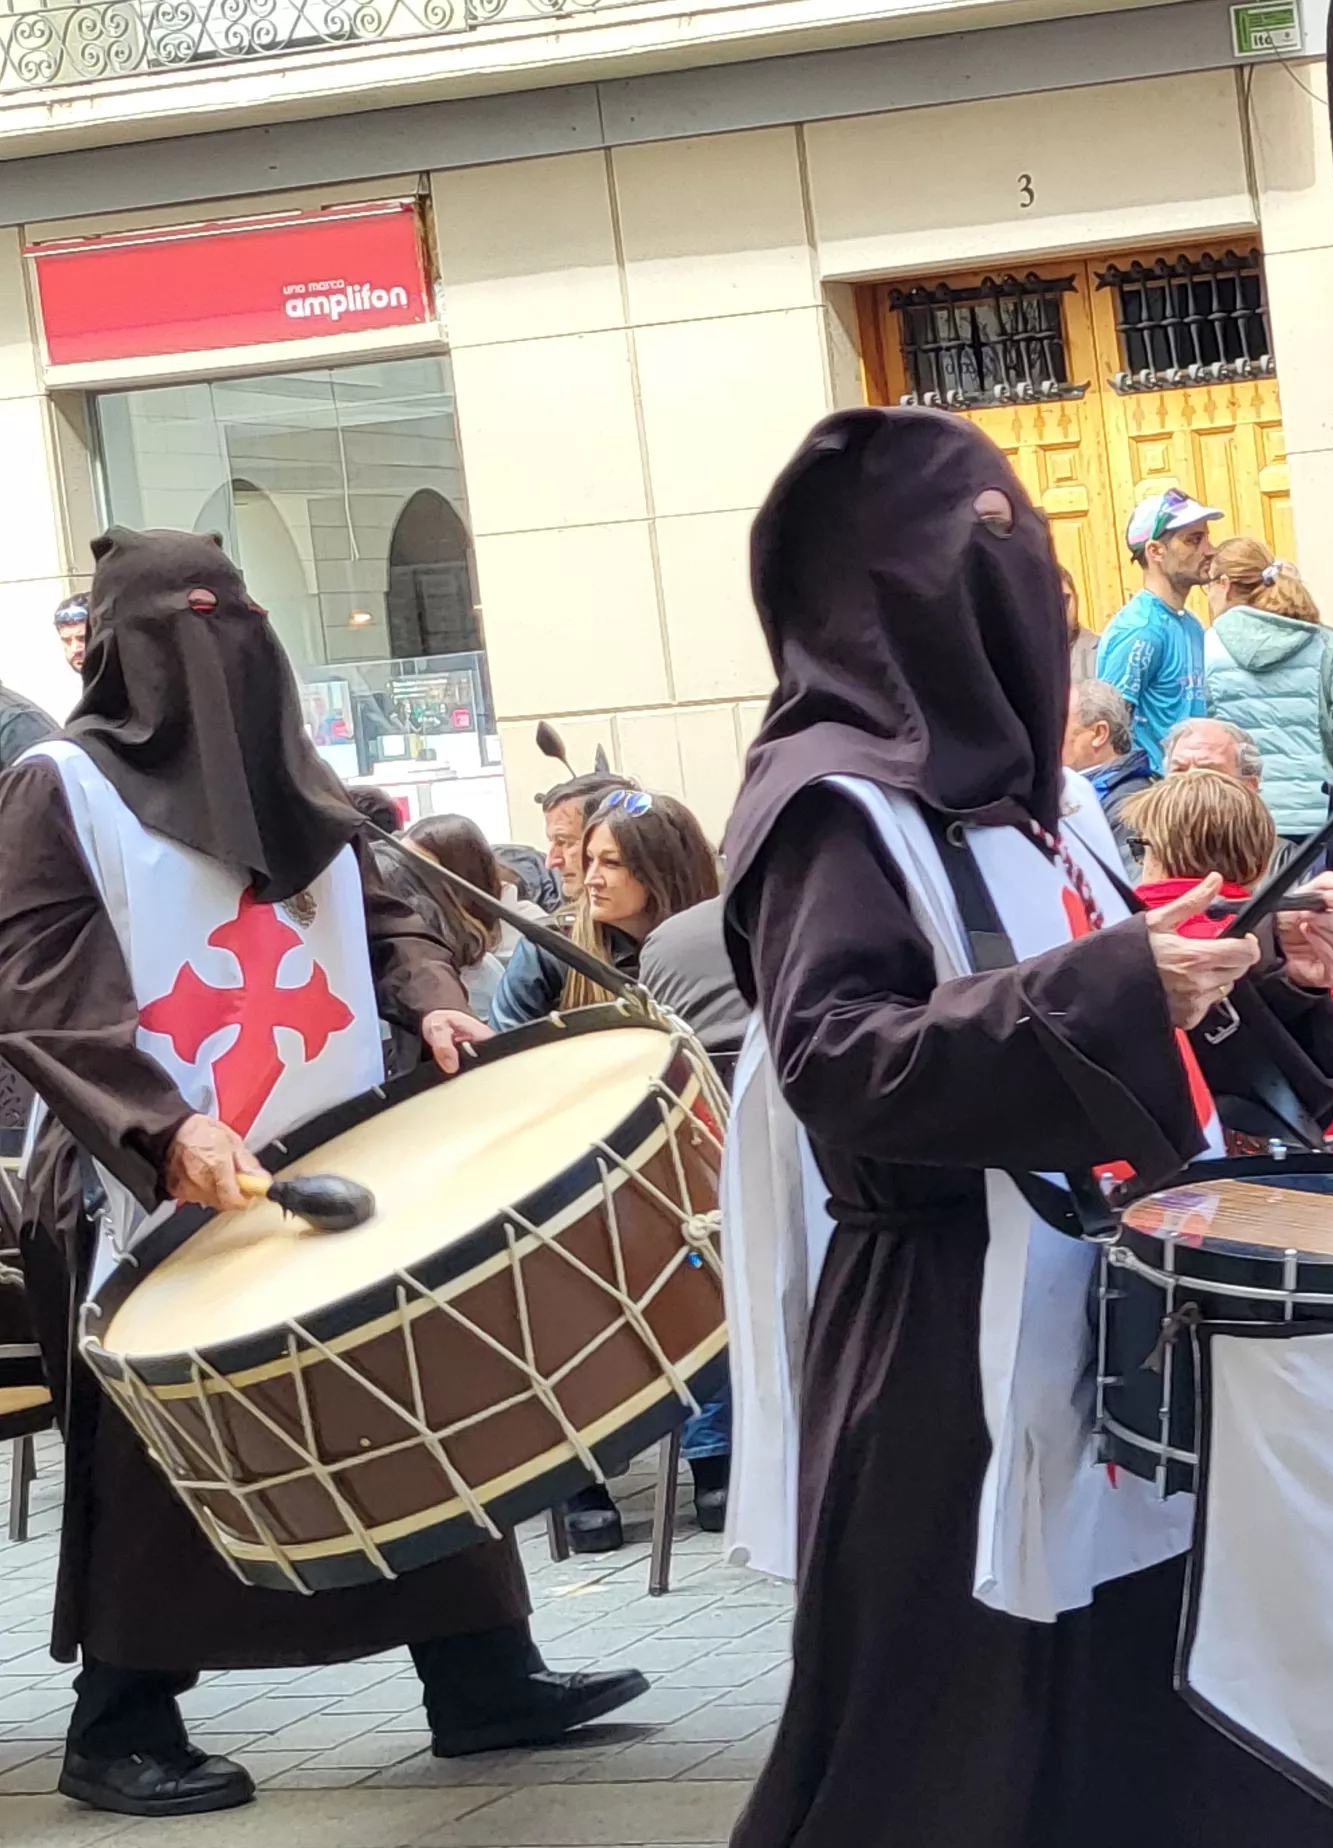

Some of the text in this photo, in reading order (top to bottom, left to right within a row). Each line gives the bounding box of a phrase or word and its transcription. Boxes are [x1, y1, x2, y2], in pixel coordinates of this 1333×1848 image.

[1018, 173, 1034, 208] 3
[283, 279, 345, 294] una marca
[285, 282, 408, 321] amplifon
